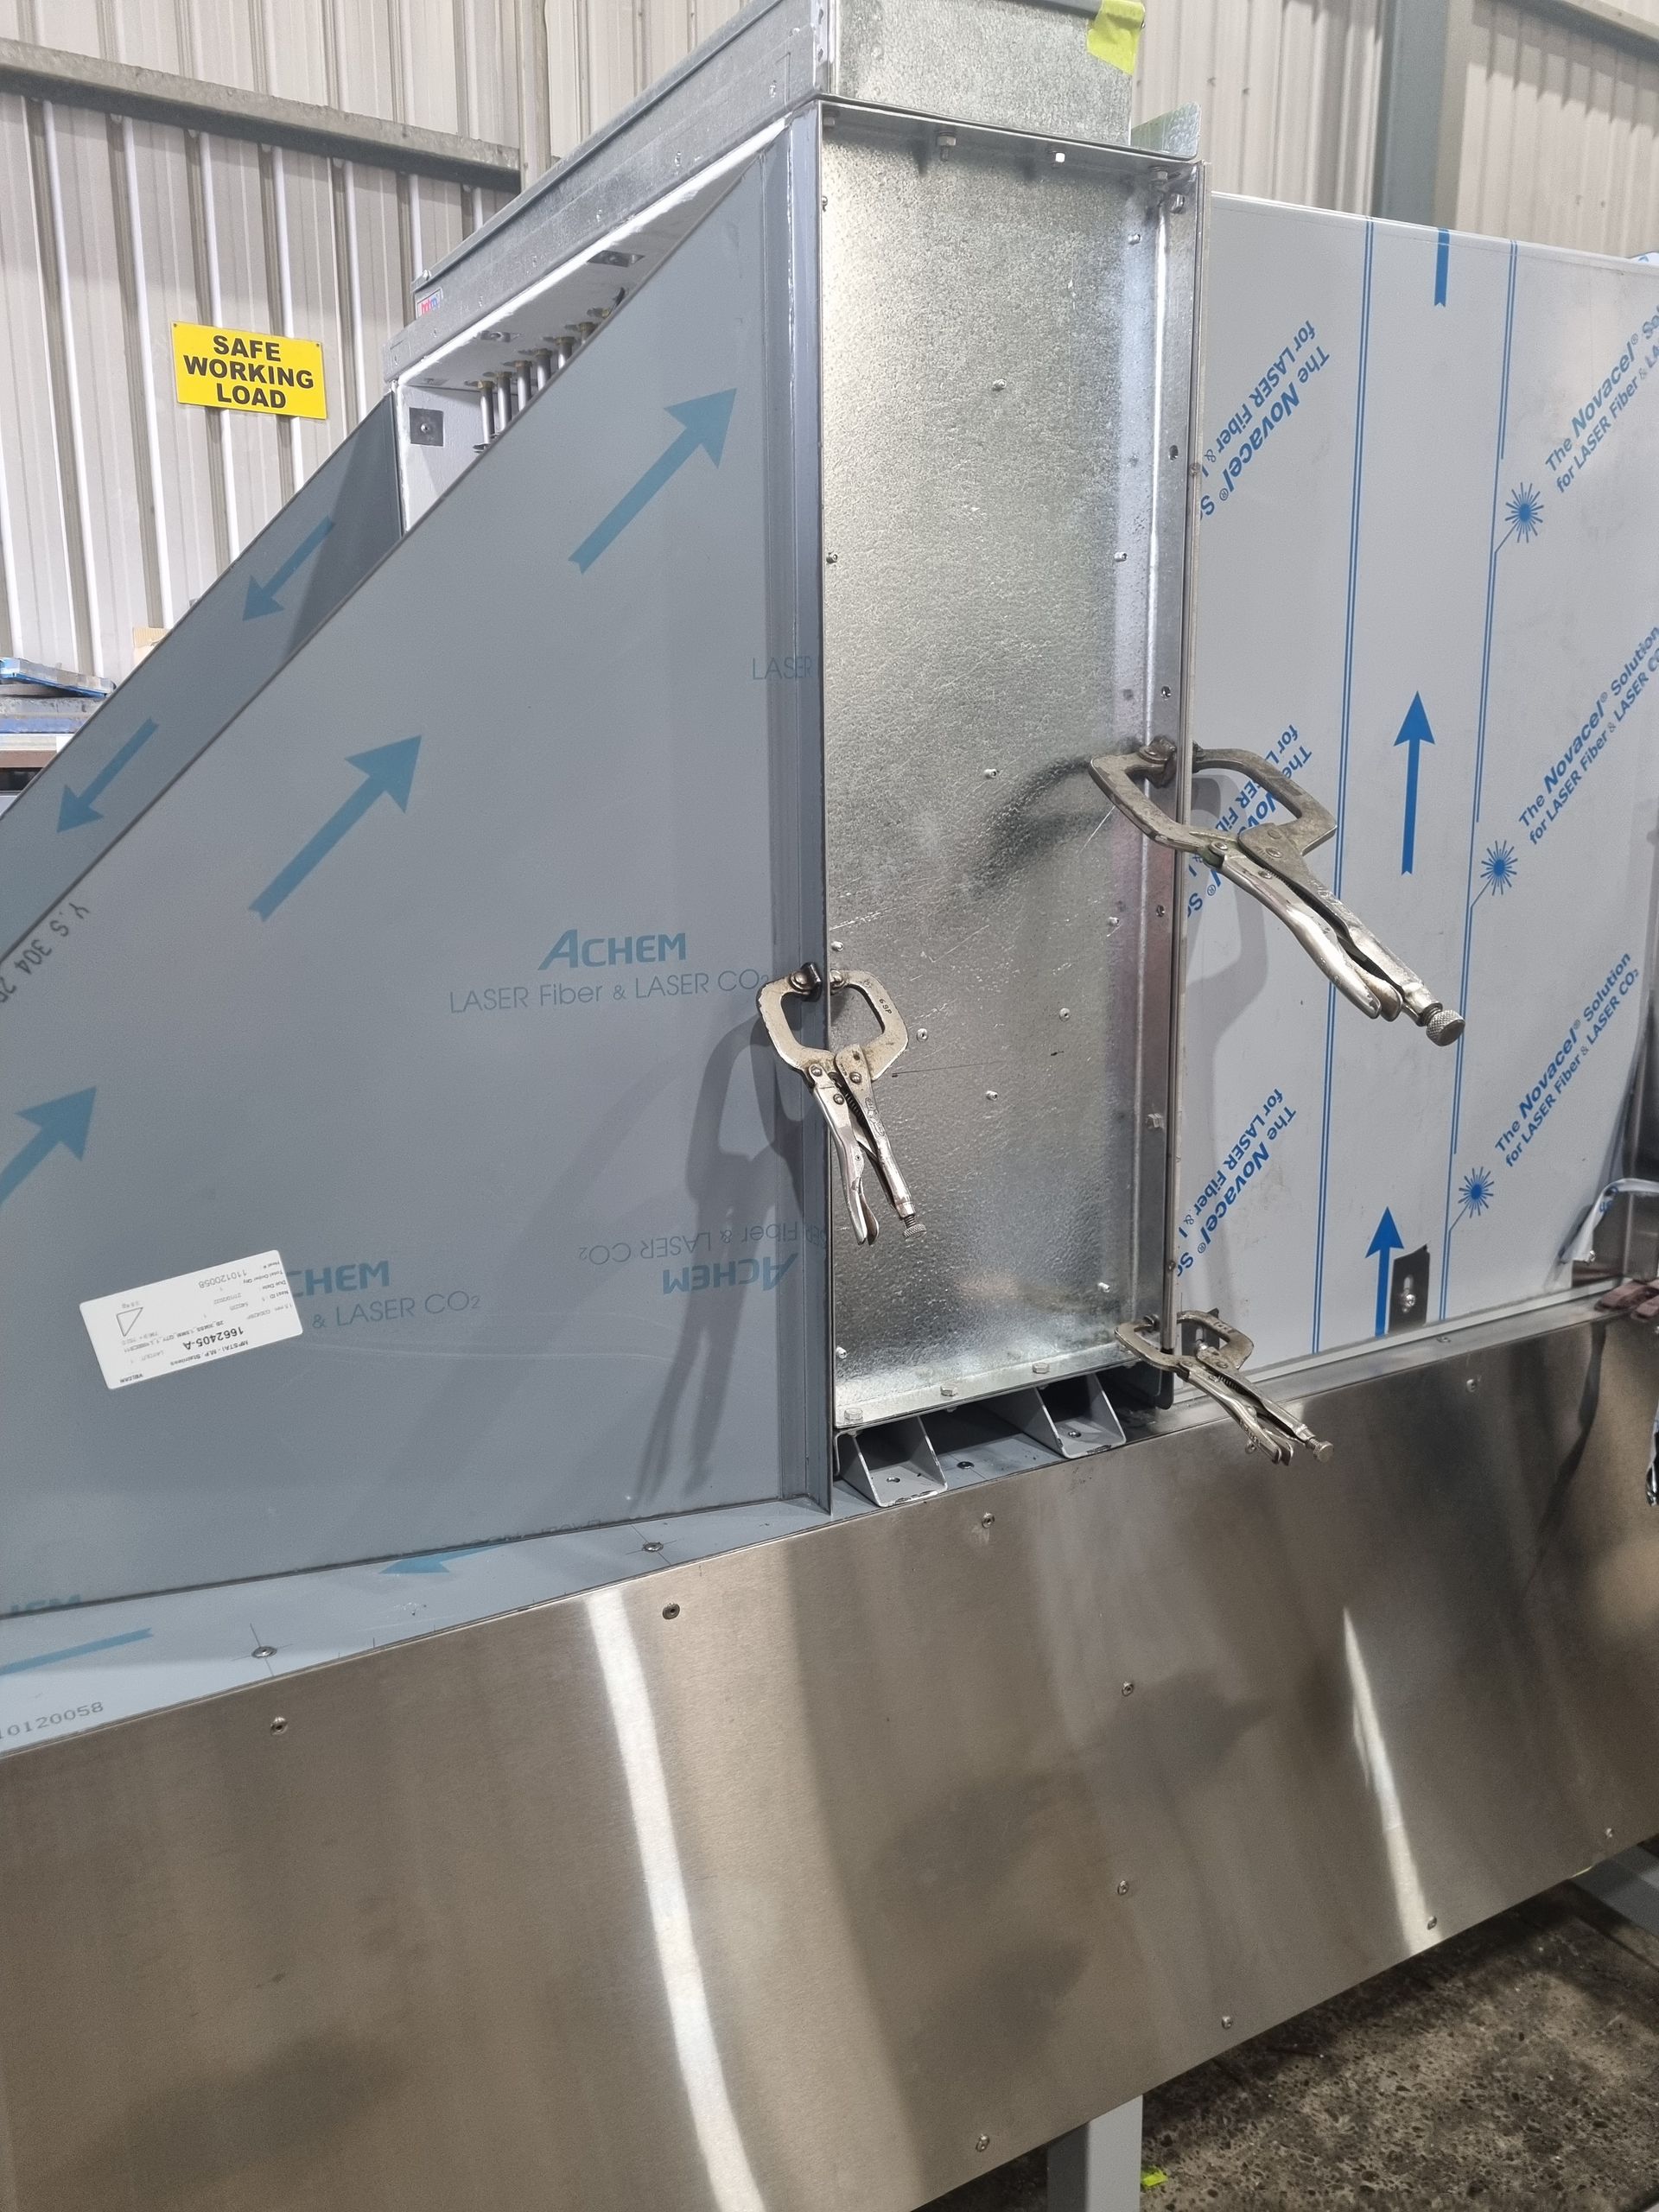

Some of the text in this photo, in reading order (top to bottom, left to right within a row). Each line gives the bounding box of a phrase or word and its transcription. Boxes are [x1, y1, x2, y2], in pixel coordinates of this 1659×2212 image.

[213, 335, 281, 362] SAFE
[1294, 320, 1315, 353] for
[183, 355, 314, 389] WORKING
[1249, 346, 1296, 409] LASER
[1296, 346, 1331, 384] The
[216, 383, 286, 409] LOAD
[1216, 403, 1254, 454] Fiber
[1556, 466, 1575, 493] for
[1573, 416, 1612, 470] LASER
[1609, 377, 1639, 419] Fiber
[1545, 437, 1573, 471] The
[752, 656, 814, 680] LASER
[1276, 724, 1300, 754] for
[1518, 794, 1545, 828] The
[1610, 626, 1659, 696] Solution
[1282, 744, 1313, 779] The
[1529, 819, 1548, 845] for
[1546, 770, 1582, 822] LASER
[1580, 730, 1608, 772] Fiber
[1614, 671, 1649, 722] LASER
[14, 939, 52, 975] 304
[537, 928, 686, 971] ACHEM
[449, 986, 528, 1014] LASER
[539, 983, 603, 1007] Fiber
[613, 983, 626, 1001] &
[635, 972, 709, 999] LASER
[1495, 1119, 1521, 1153] The
[1583, 953, 1631, 1022] Solution
[1504, 1143, 1524, 1167] for
[1521, 1093, 1557, 1144] LASER
[1554, 1054, 1581, 1095] Fiber
[1586, 995, 1621, 1046] LASER
[1262, 1088, 1283, 1116] for
[1267, 1106, 1297, 1141] The
[1224, 1115, 1265, 1171] LASER
[1193, 1170, 1227, 1217] Fiber
[640, 1231, 711, 1260] LASER
[721, 1229, 733, 1244] &
[741, 1221, 798, 1243] Fiber
[199, 1269, 247, 1288] 110120058
[286, 1260, 390, 1298] HEM
[663, 1253, 799, 1295] ACHEM
[312, 1313, 327, 1329] &
[336, 1296, 415, 1327] LASER
[182, 1326, 244, 1350] 1662405-A
